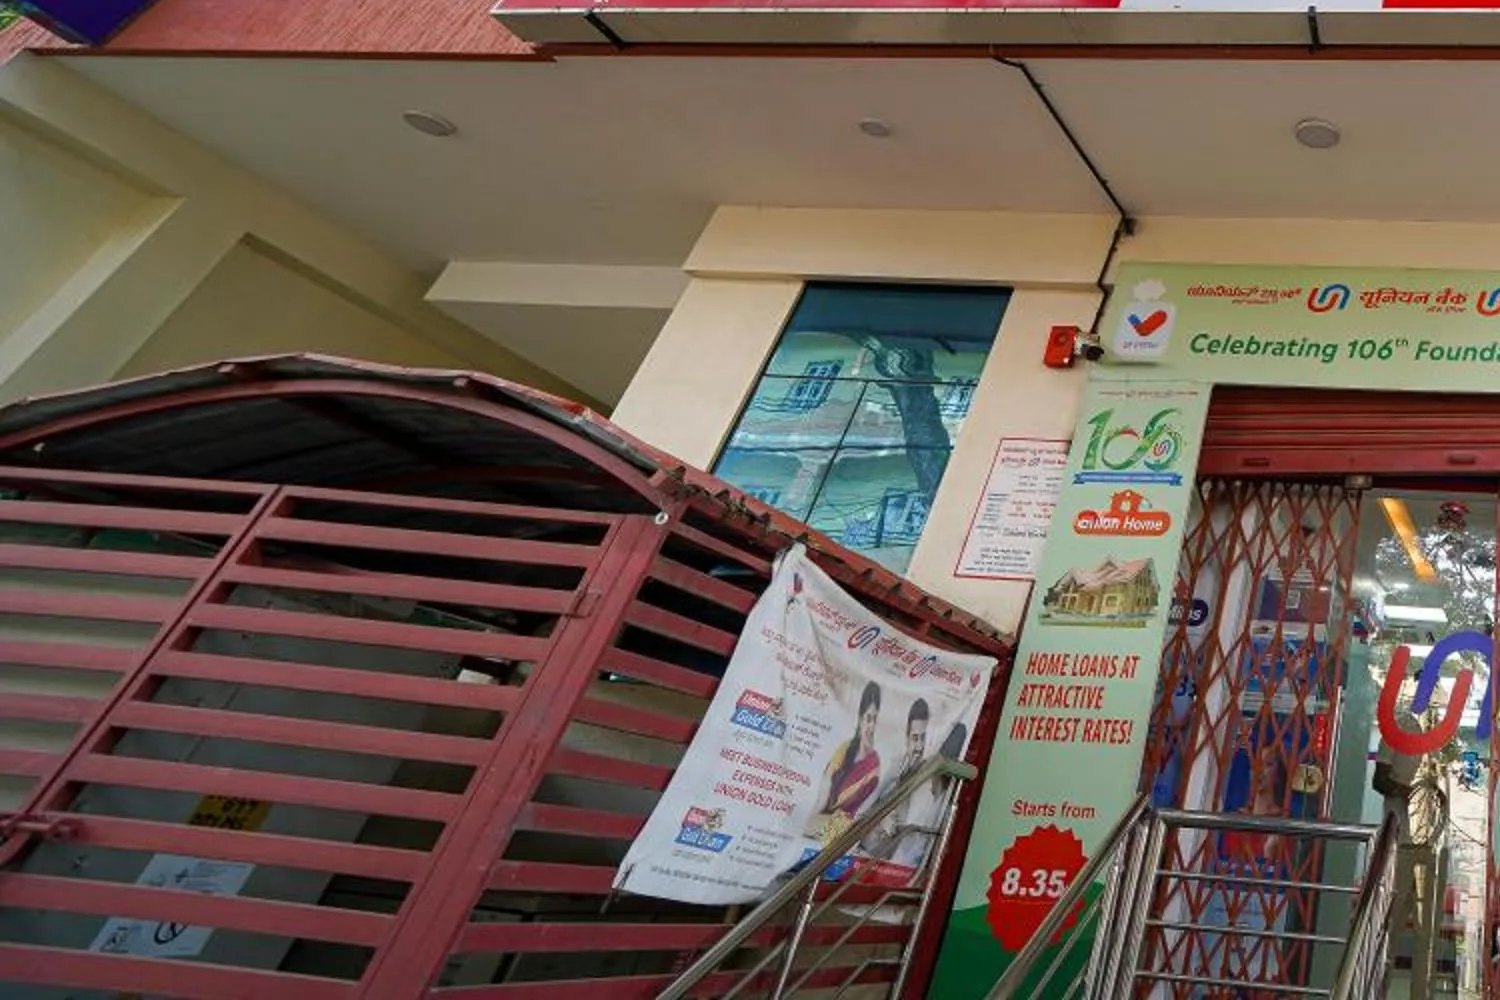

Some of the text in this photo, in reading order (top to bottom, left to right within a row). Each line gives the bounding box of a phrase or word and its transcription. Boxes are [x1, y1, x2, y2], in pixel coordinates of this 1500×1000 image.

[1359, 287, 1430, 309] यूनियन
[1189, 332, 1338, 363] Celebrating
[1122, 516, 1164, 531] Home
[1025, 652, 1141, 679] HOME LOANS AT
[1017, 684, 1104, 709] ATTRACTIVE
[1010, 715, 1133, 745] INTEREST RATES!
[1010, 799, 1096, 819] Starts from
